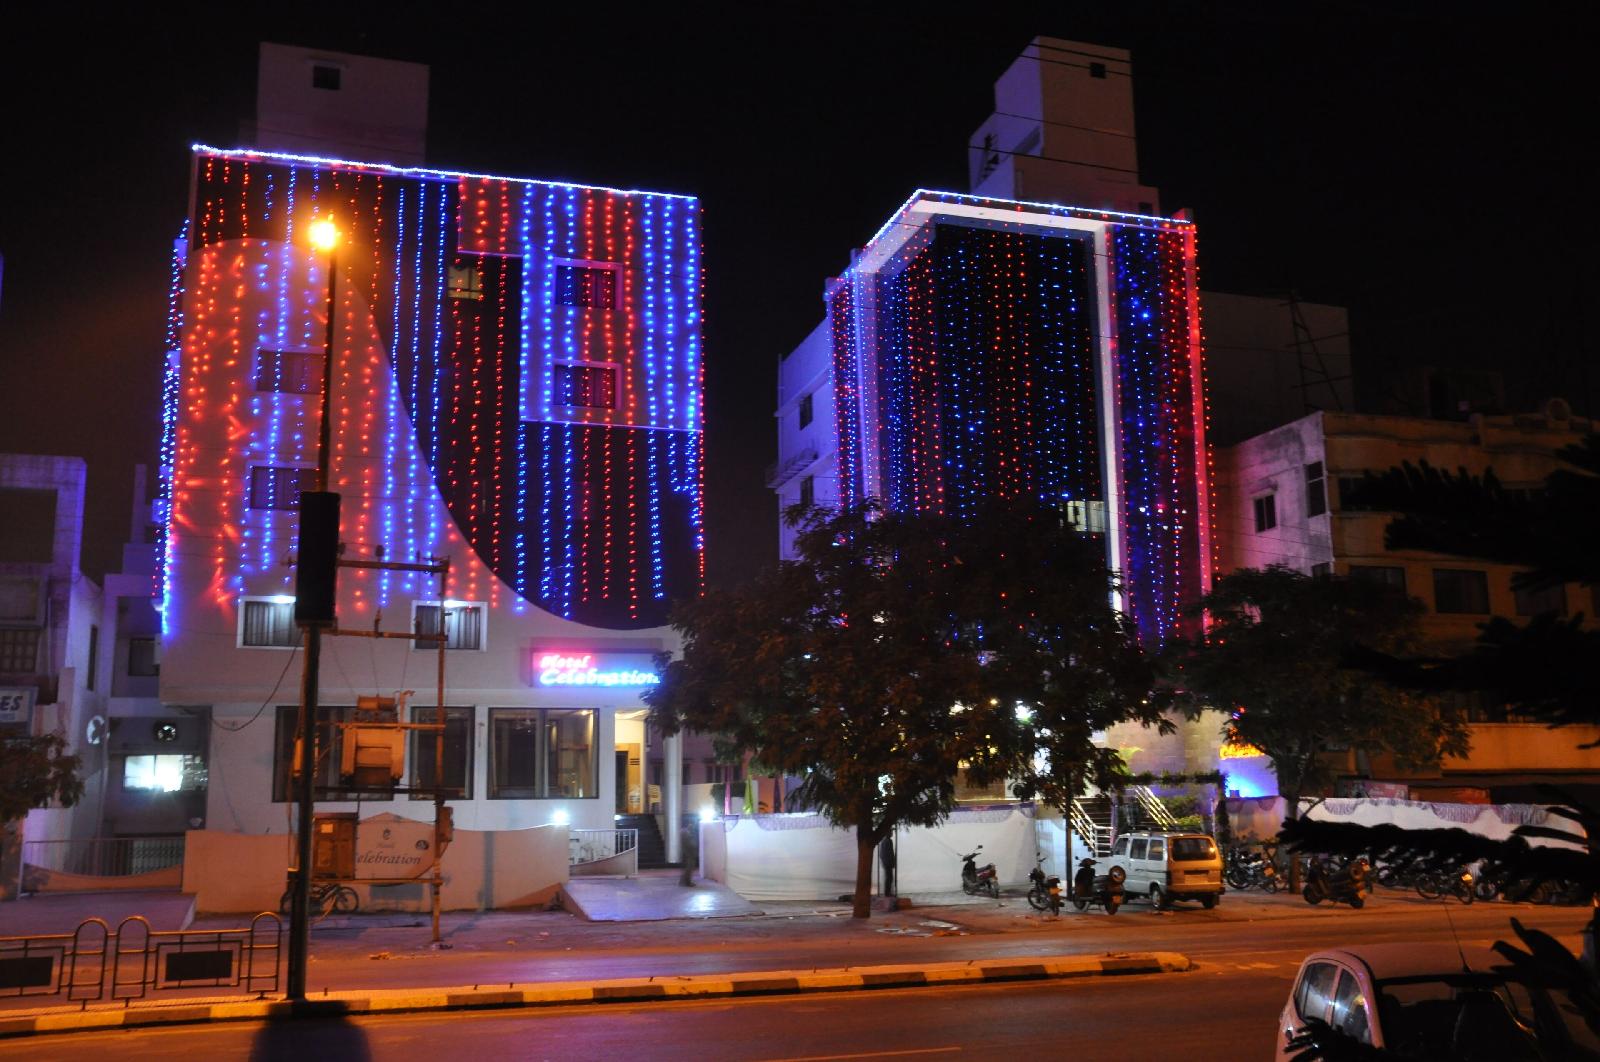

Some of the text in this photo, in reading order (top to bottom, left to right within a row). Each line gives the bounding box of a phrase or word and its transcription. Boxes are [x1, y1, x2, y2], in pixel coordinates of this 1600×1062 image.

[540, 654, 591, 669] Hotel
[539, 668, 660, 686] Celebration
[355, 850, 422, 865] elebration
